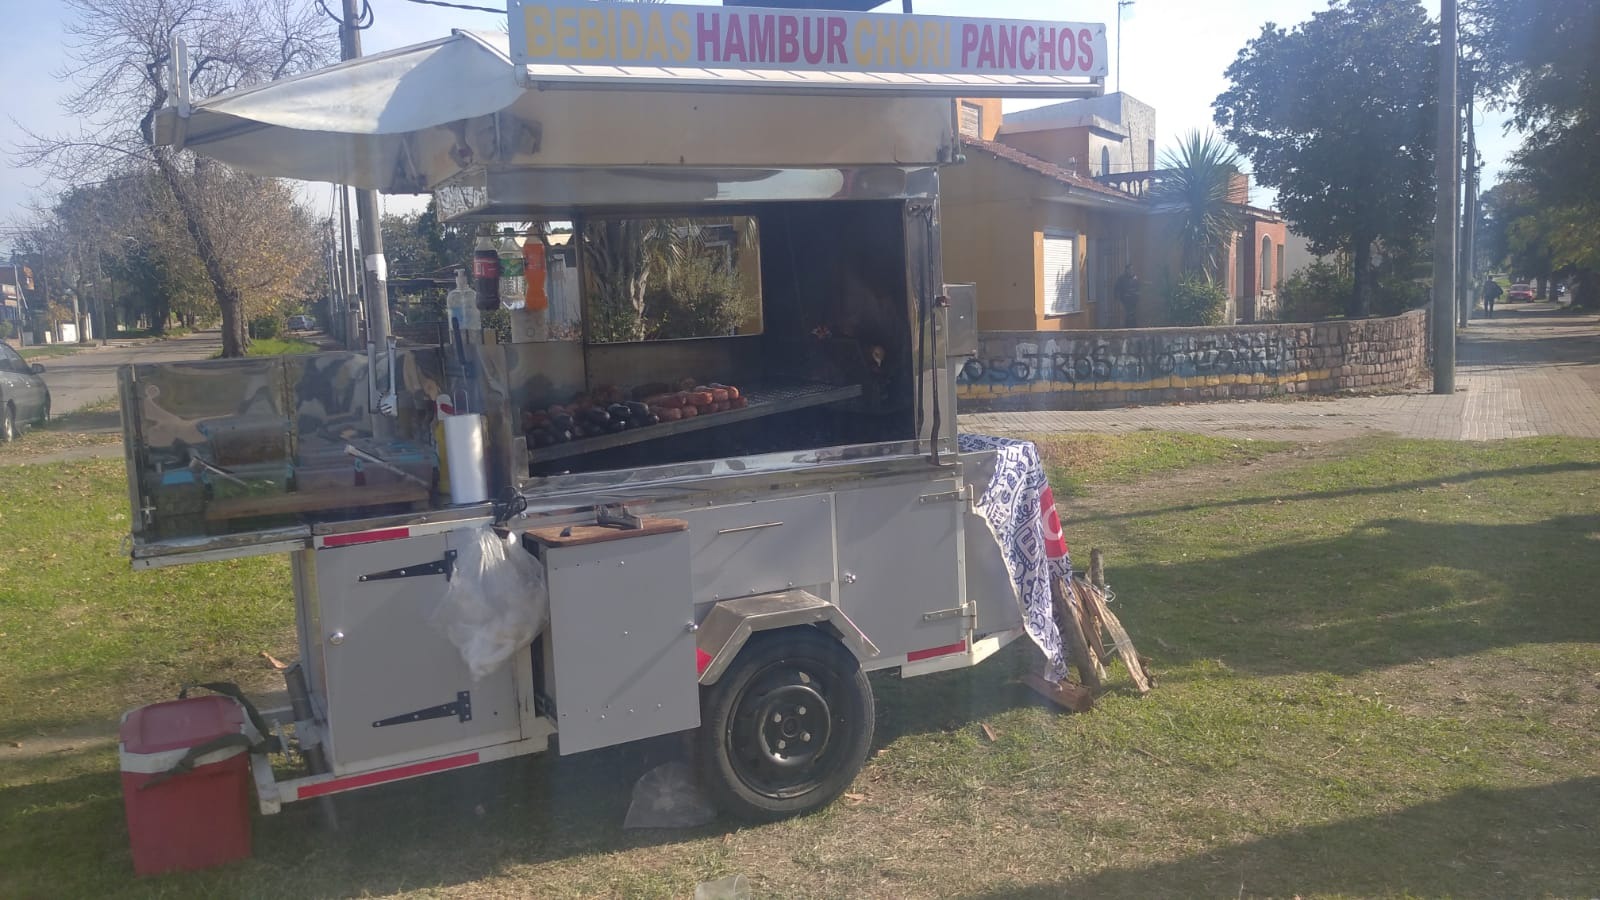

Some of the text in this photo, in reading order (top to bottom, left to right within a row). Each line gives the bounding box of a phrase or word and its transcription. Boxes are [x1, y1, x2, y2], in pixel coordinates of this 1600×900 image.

[524, 6, 1094, 71] BEBIDAS HAMBUR CHORI PANCHOS
